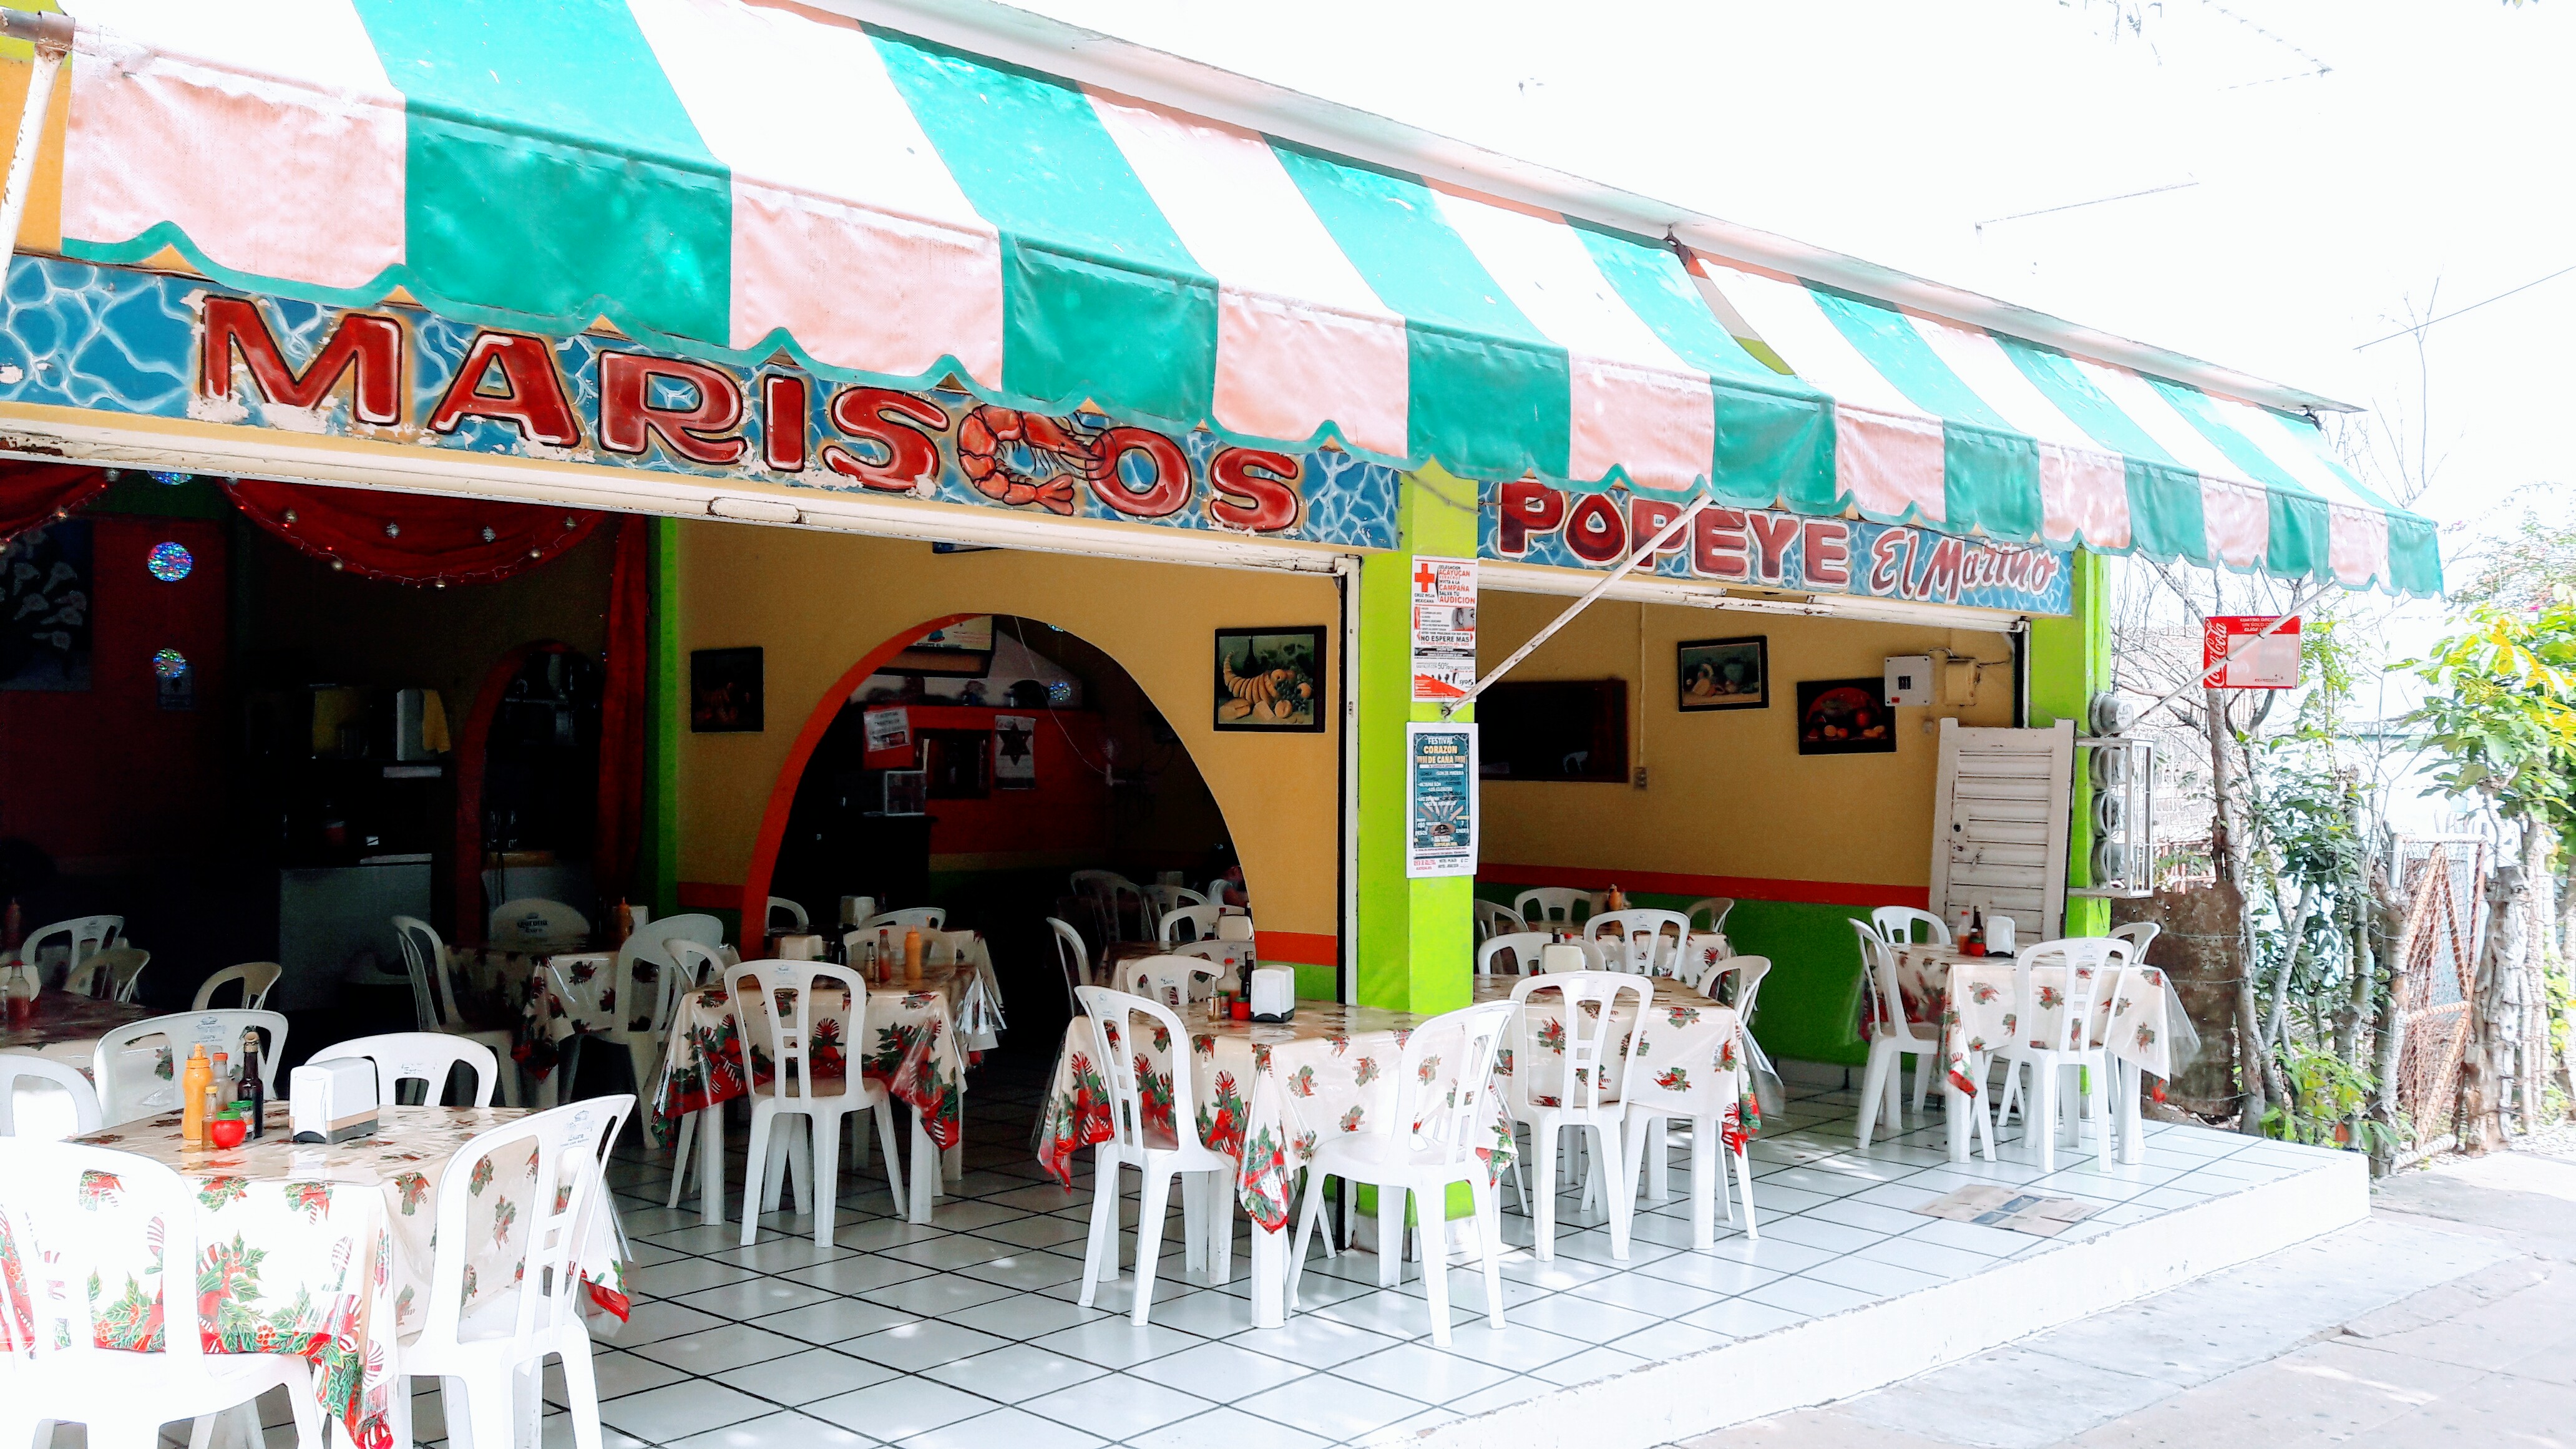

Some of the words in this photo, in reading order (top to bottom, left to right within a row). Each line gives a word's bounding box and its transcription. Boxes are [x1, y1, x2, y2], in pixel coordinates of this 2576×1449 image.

[201, 294, 1300, 531] MARISCOS
[1498, 479, 1850, 588] POPEYE
[1869, 526, 1920, 600] El
[1915, 535, 2060, 604] Marino
[1438, 568, 1470, 577] ACAYUCAN
[1439, 584, 1470, 592] CAMPAÑA
[1440, 596, 1476, 604] AUDICION
[2205, 618, 2227, 686] Coa-Cola
